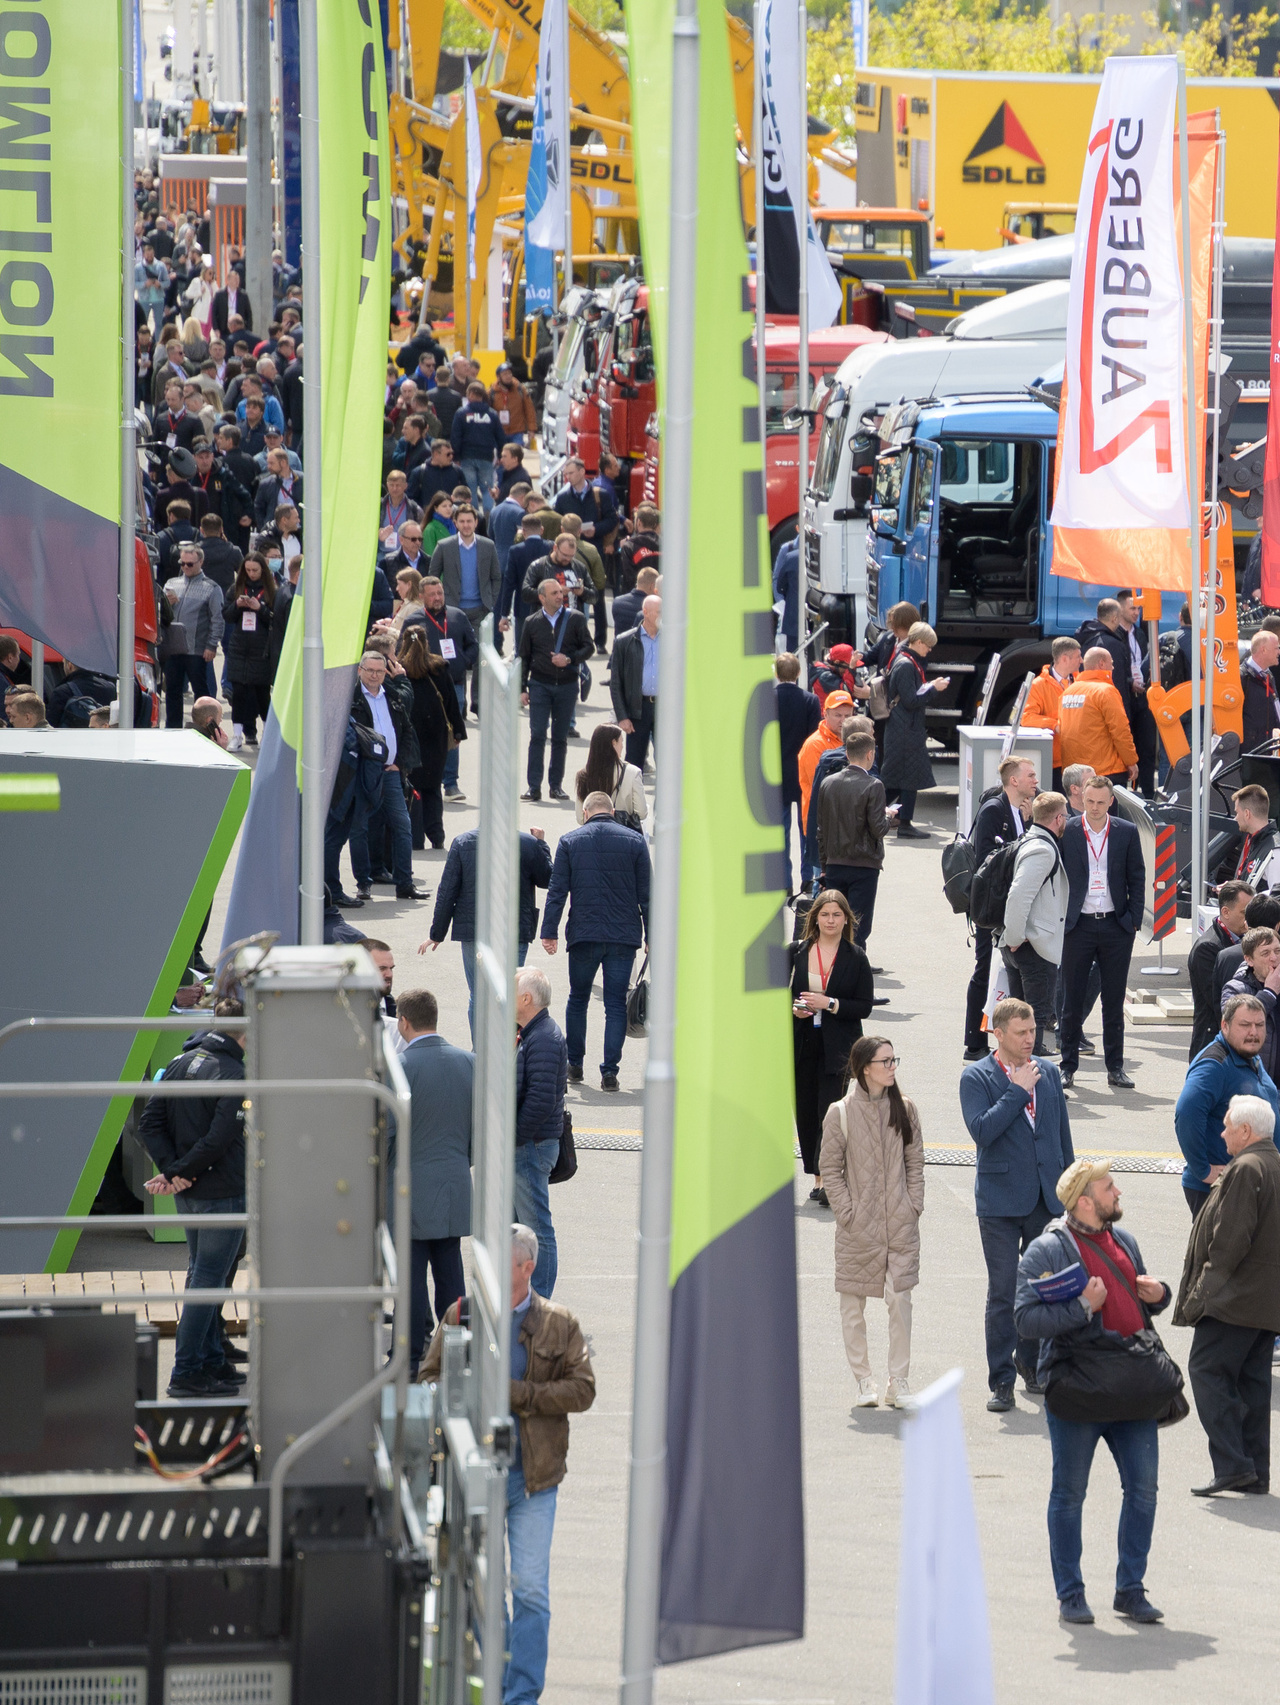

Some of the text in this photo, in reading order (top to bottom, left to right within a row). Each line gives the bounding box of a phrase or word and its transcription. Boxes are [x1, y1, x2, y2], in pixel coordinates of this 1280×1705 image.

[570, 158, 632, 184] SDL
[962, 165, 1046, 185] SDLG
[466, 413, 491, 424] FILA
